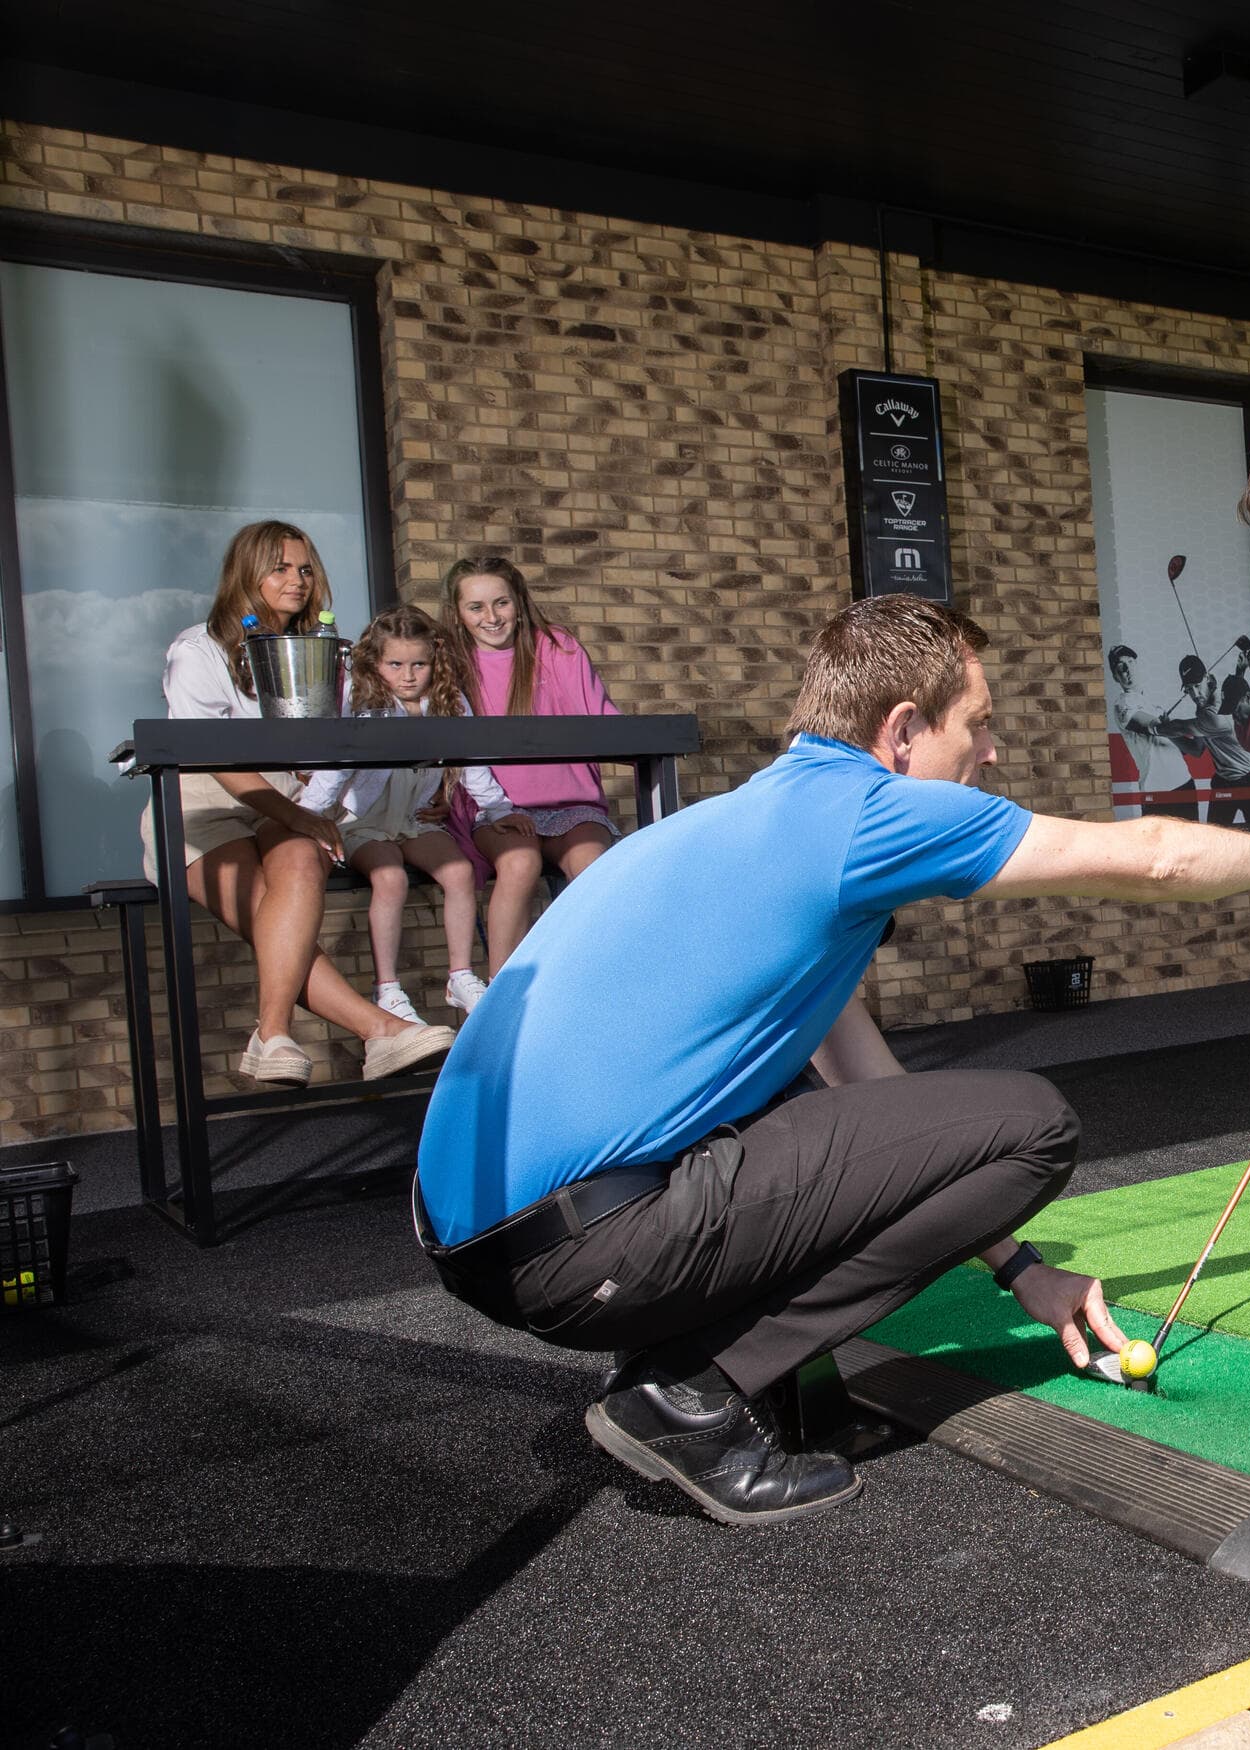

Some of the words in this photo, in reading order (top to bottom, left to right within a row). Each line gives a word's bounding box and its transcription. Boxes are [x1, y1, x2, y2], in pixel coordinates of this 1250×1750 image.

[875, 398, 919, 419] Callaway
[873, 459, 900, 468] CELTIC
[901, 462, 929, 470] MANOR
[884, 518, 927, 527] TOPTRACER
[893, 524, 919, 532] RANGE
